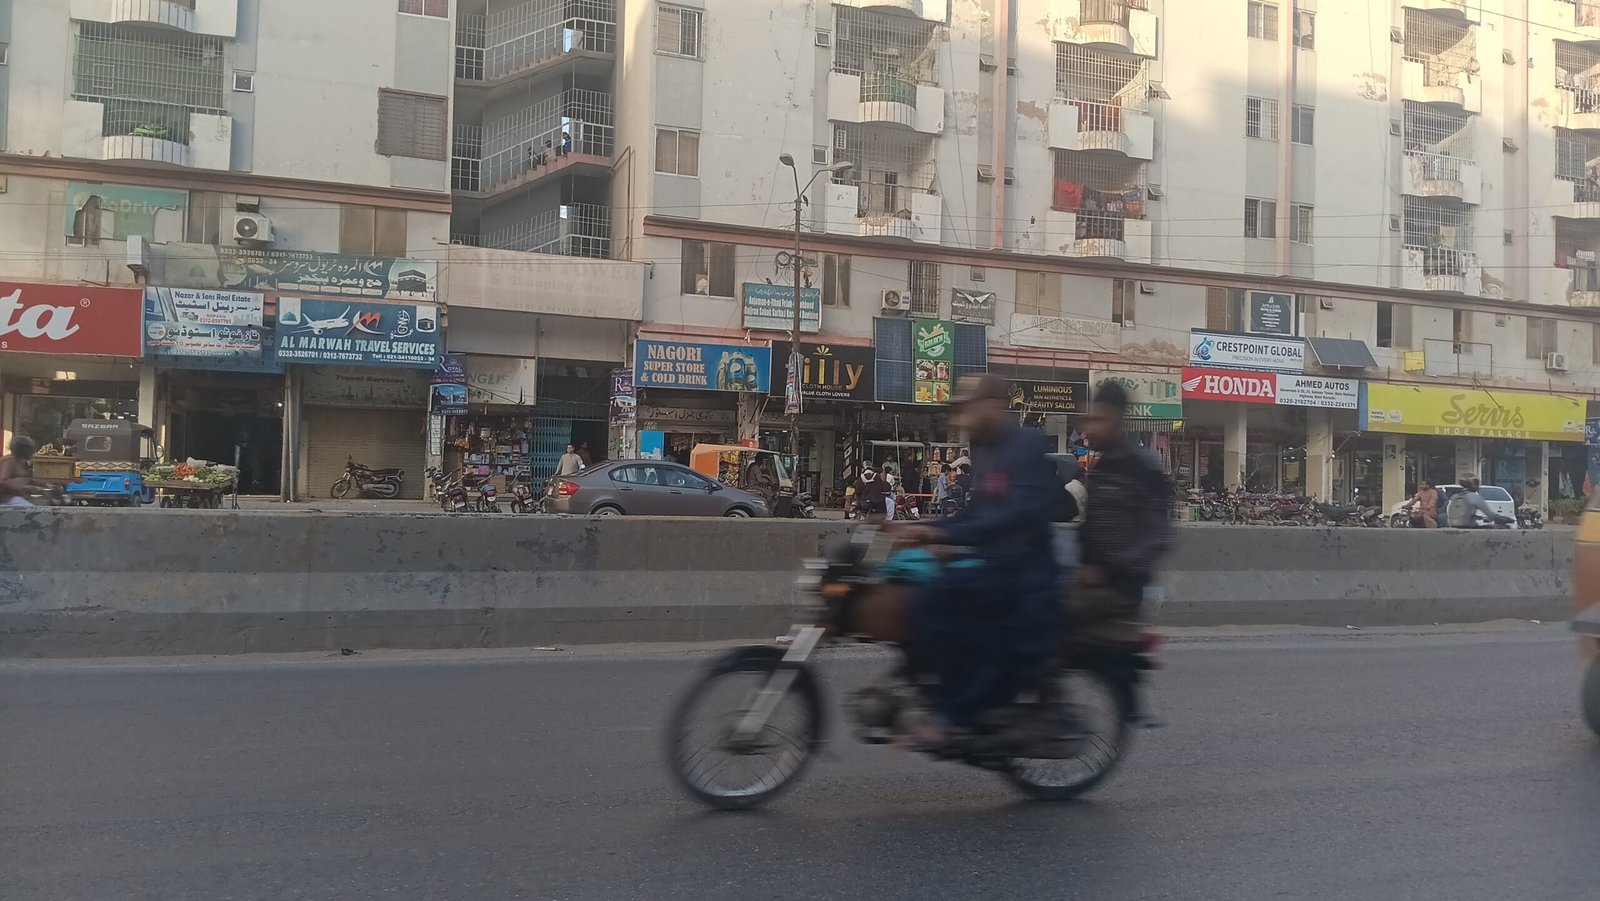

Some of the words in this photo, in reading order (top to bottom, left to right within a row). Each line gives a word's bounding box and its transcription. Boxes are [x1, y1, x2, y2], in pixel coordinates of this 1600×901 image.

[175, 291, 194, 299] Nazar
[216, 293, 231, 301] Real
[232, 295, 251, 303] Estate
[281, 336, 295, 348] AL
[298, 336, 351, 350] MARWAH
[355, 339, 390, 352] TRAVEL
[391, 341, 436, 355] SERVICES
[1216, 341, 1269, 355] CRESTPOINT
[1271, 346, 1302, 358] GLOBAL
[647, 344, 702, 361] NAGORI
[644, 361, 673, 372] SUPER
[675, 362, 705, 373] STORE
[785, 357, 864, 390] illy
[640, 372, 649, 382] &
[652, 372, 676, 384] COLD
[678, 374, 707, 385] DRINK
[1295, 380, 1322, 389] AHMED
[1324, 381, 1350, 390] AUTOS
[1033, 385, 1072, 394] LUMINIOUS
[1204, 375, 1275, 397] HONDA
[1434, 426, 1470, 436] SHOE
[1480, 429, 1531, 439] PALACE
